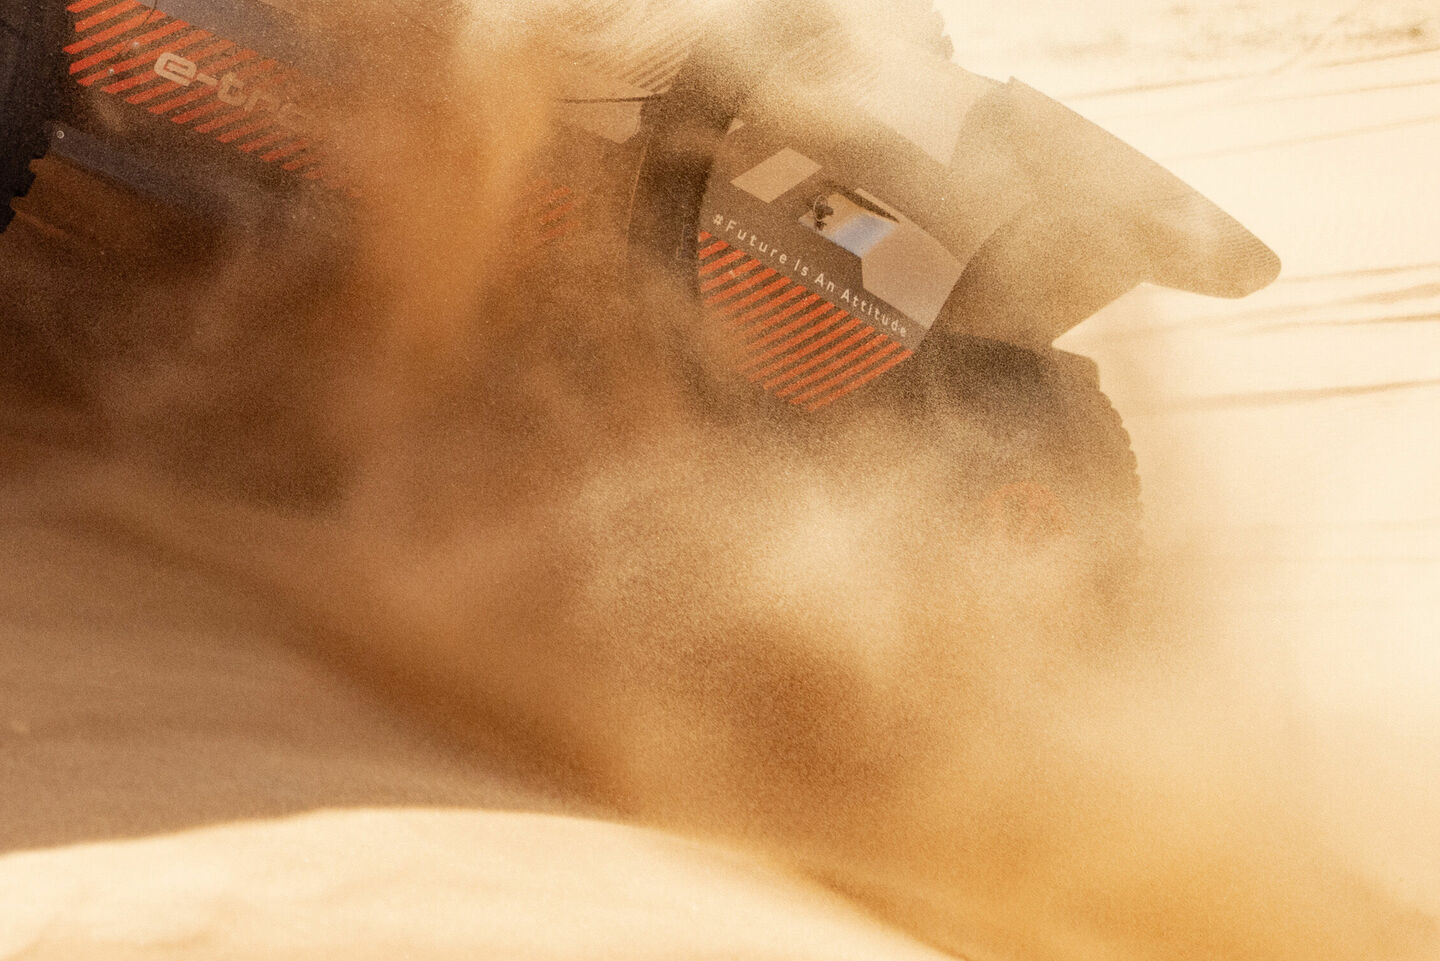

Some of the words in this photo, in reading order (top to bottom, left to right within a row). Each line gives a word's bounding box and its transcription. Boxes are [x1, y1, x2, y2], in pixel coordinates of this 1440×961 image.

[712, 213, 788, 265] #Future
[793, 258, 810, 277] Is
[814, 272, 836, 293] An
[840, 288, 908, 338] Attitude
